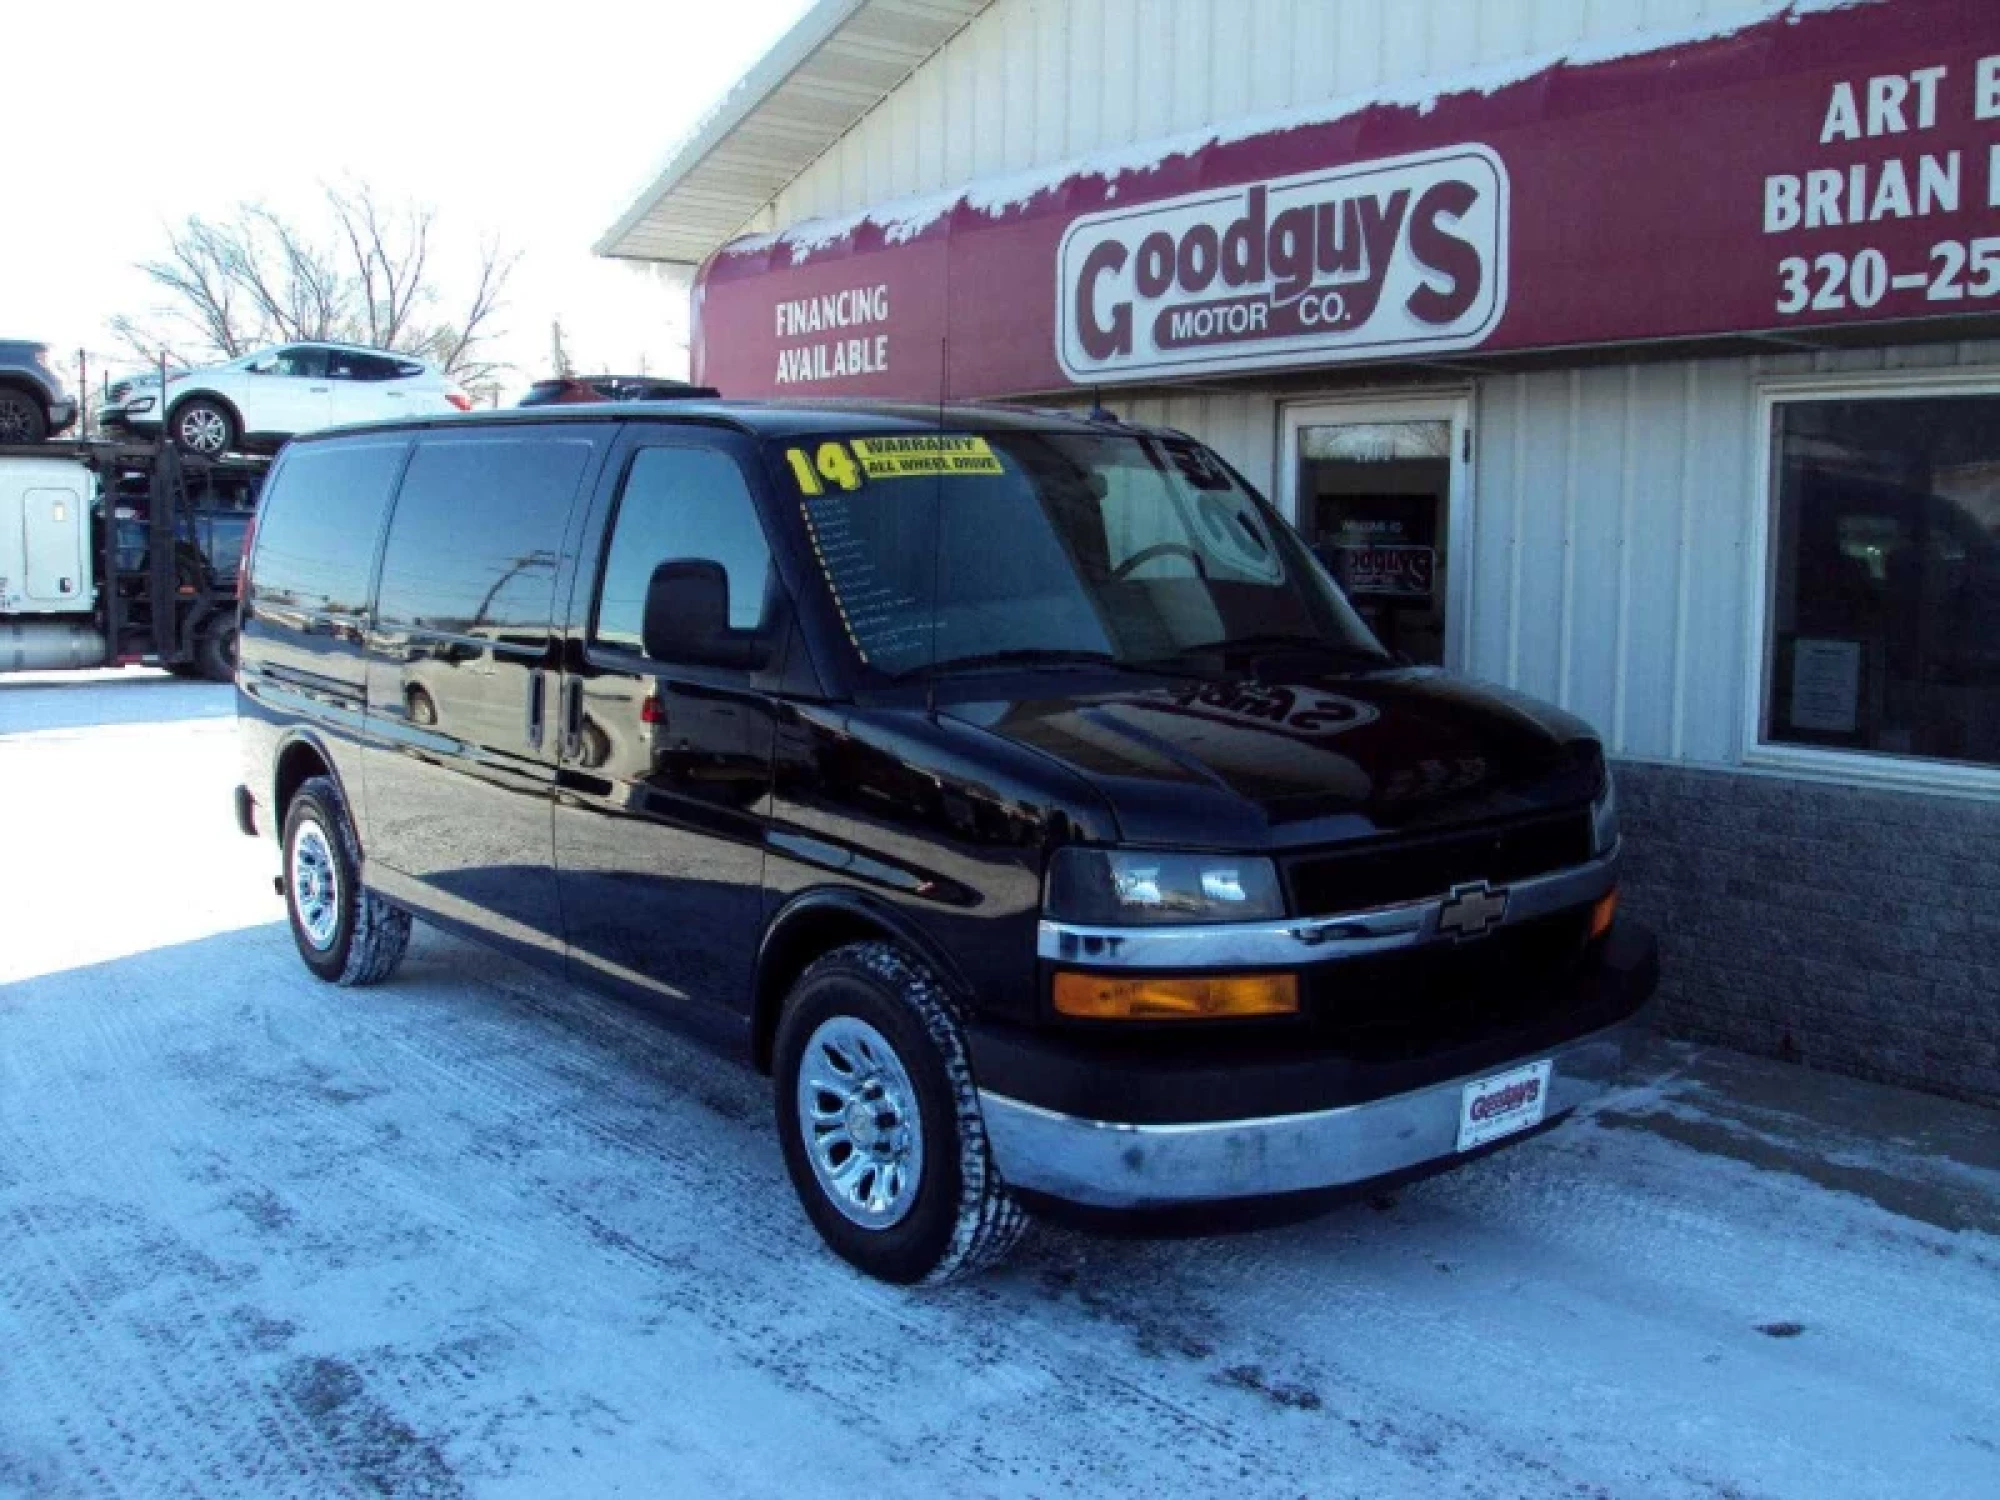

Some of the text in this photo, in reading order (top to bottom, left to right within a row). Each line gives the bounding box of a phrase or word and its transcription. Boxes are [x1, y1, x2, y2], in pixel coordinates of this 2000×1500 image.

[1819, 64, 1948, 144] ART
[1763, 150, 1961, 233] BRIAN
[776, 284, 888, 336] FINANCING
[1171, 292, 1351, 341] MOTOR CO.
[776, 334, 888, 384] AVAILABLE
[786, 442, 861, 495] 14
[864, 438, 975, 453] WARRANTY
[869, 459, 895, 472] ALL
